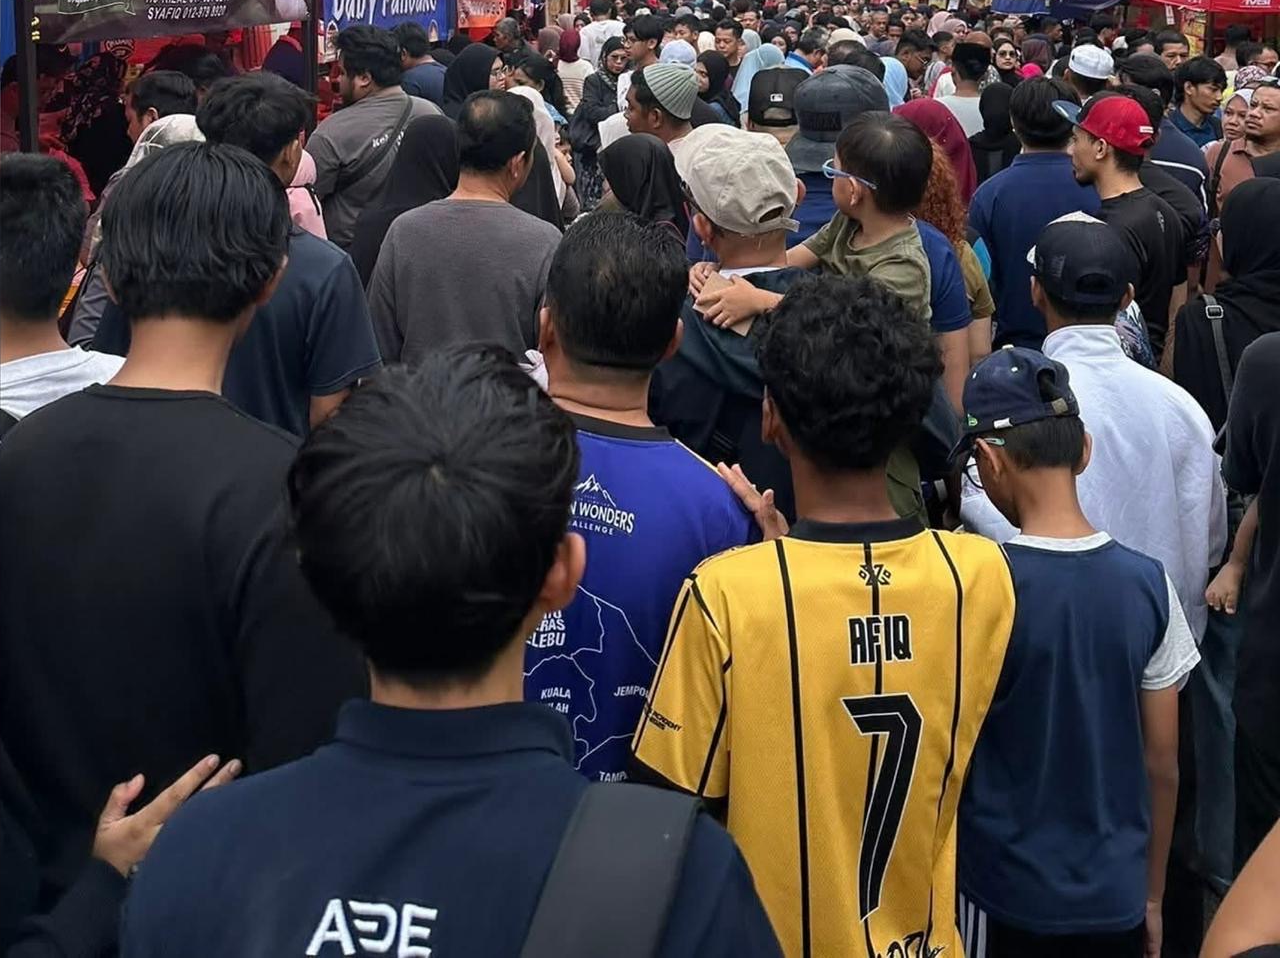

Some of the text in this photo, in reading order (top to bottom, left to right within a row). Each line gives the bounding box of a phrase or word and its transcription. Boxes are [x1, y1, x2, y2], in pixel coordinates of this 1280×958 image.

[147, 6, 182, 20] SYAFIQ
[579, 502, 635, 533] WONDERS
[568, 520, 614, 535] ALLENGE
[536, 618, 566, 632] RAS
[540, 687, 571, 700] KUALA
[840, 693, 924, 922] 7
